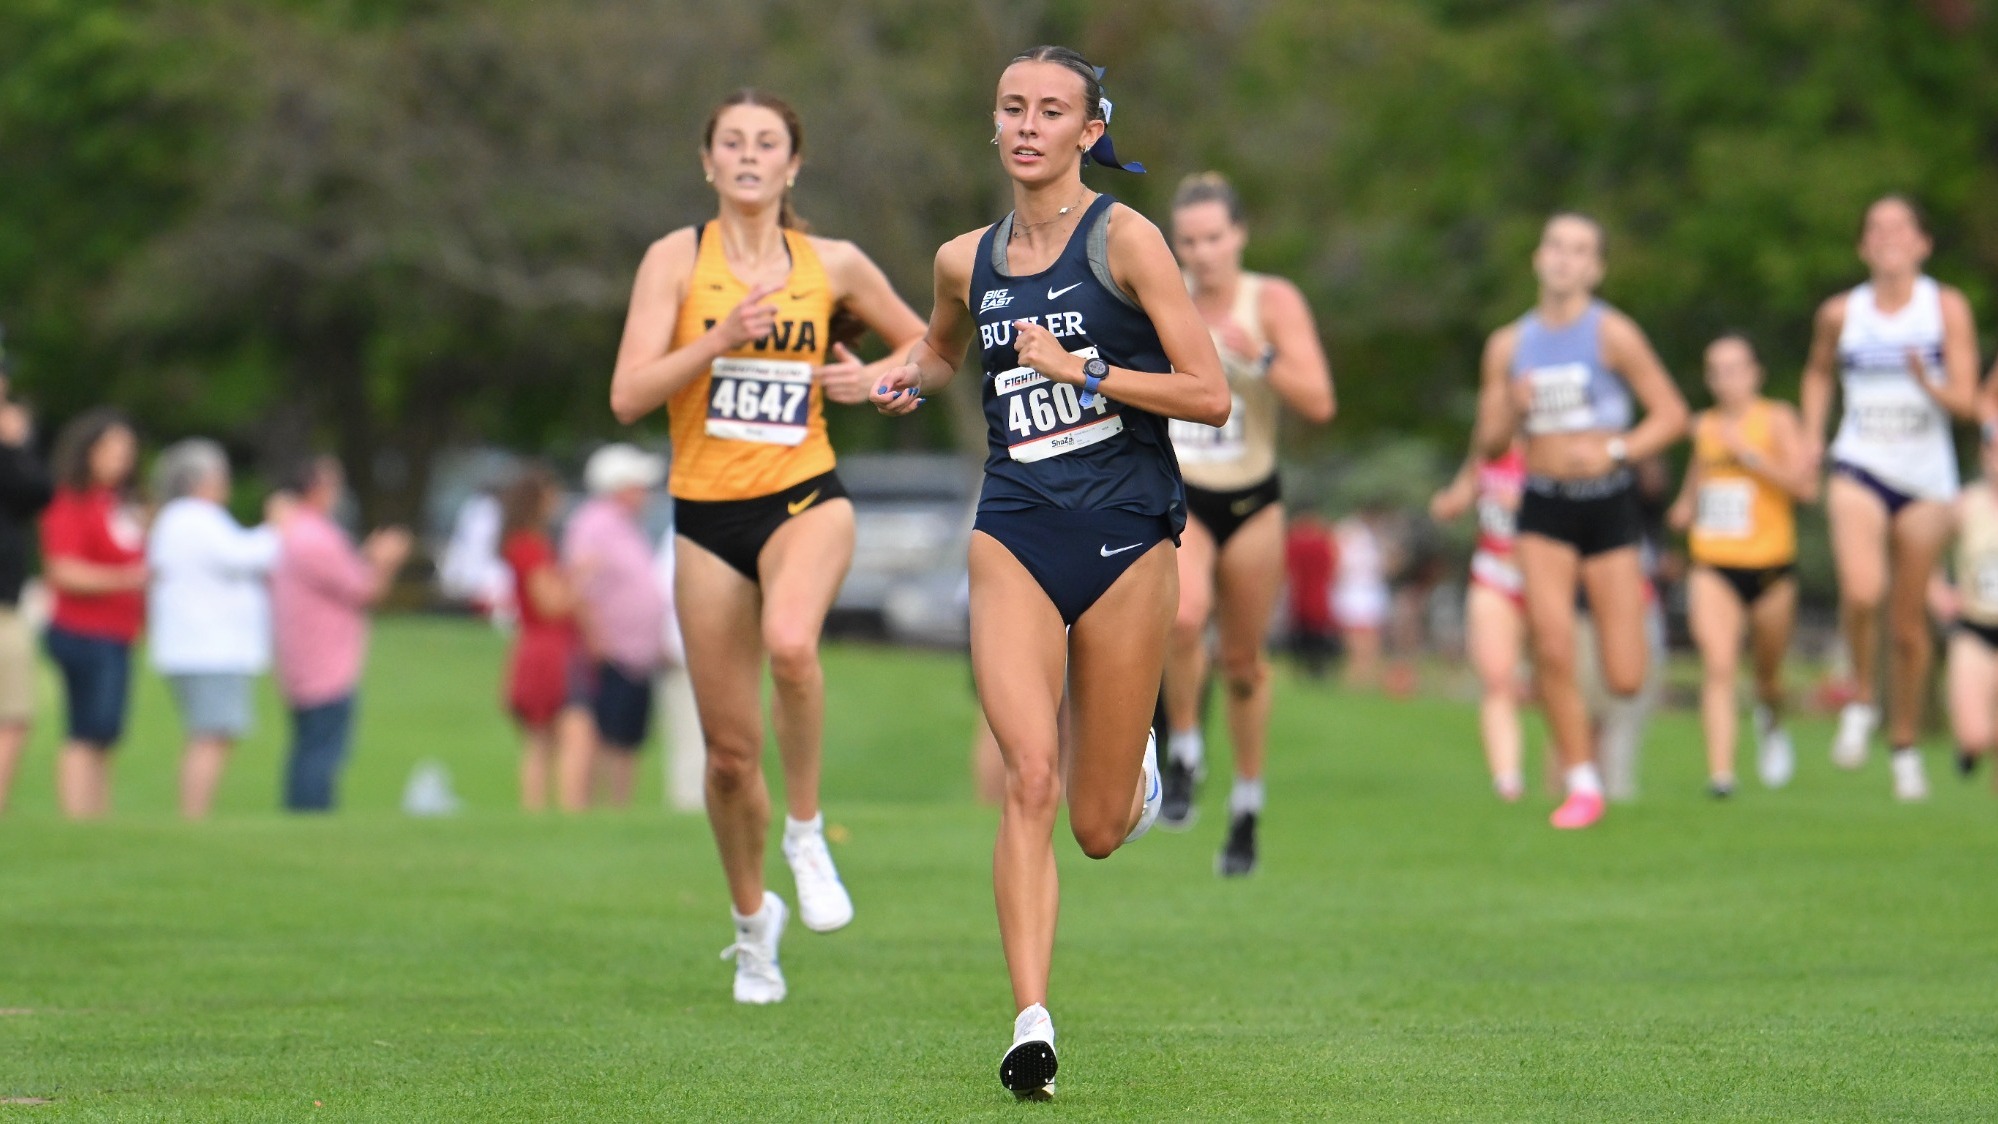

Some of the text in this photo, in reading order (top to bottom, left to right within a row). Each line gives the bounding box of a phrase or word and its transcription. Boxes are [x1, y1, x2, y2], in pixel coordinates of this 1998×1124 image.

[981, 296, 1014, 309] EAST
[984, 289, 1009, 300] BIG
[704, 319, 815, 351] WA
[980, 311, 1087, 350] BUER
[1004, 371, 1042, 389] FIGHTI
[712, 379, 807, 423] 4647
